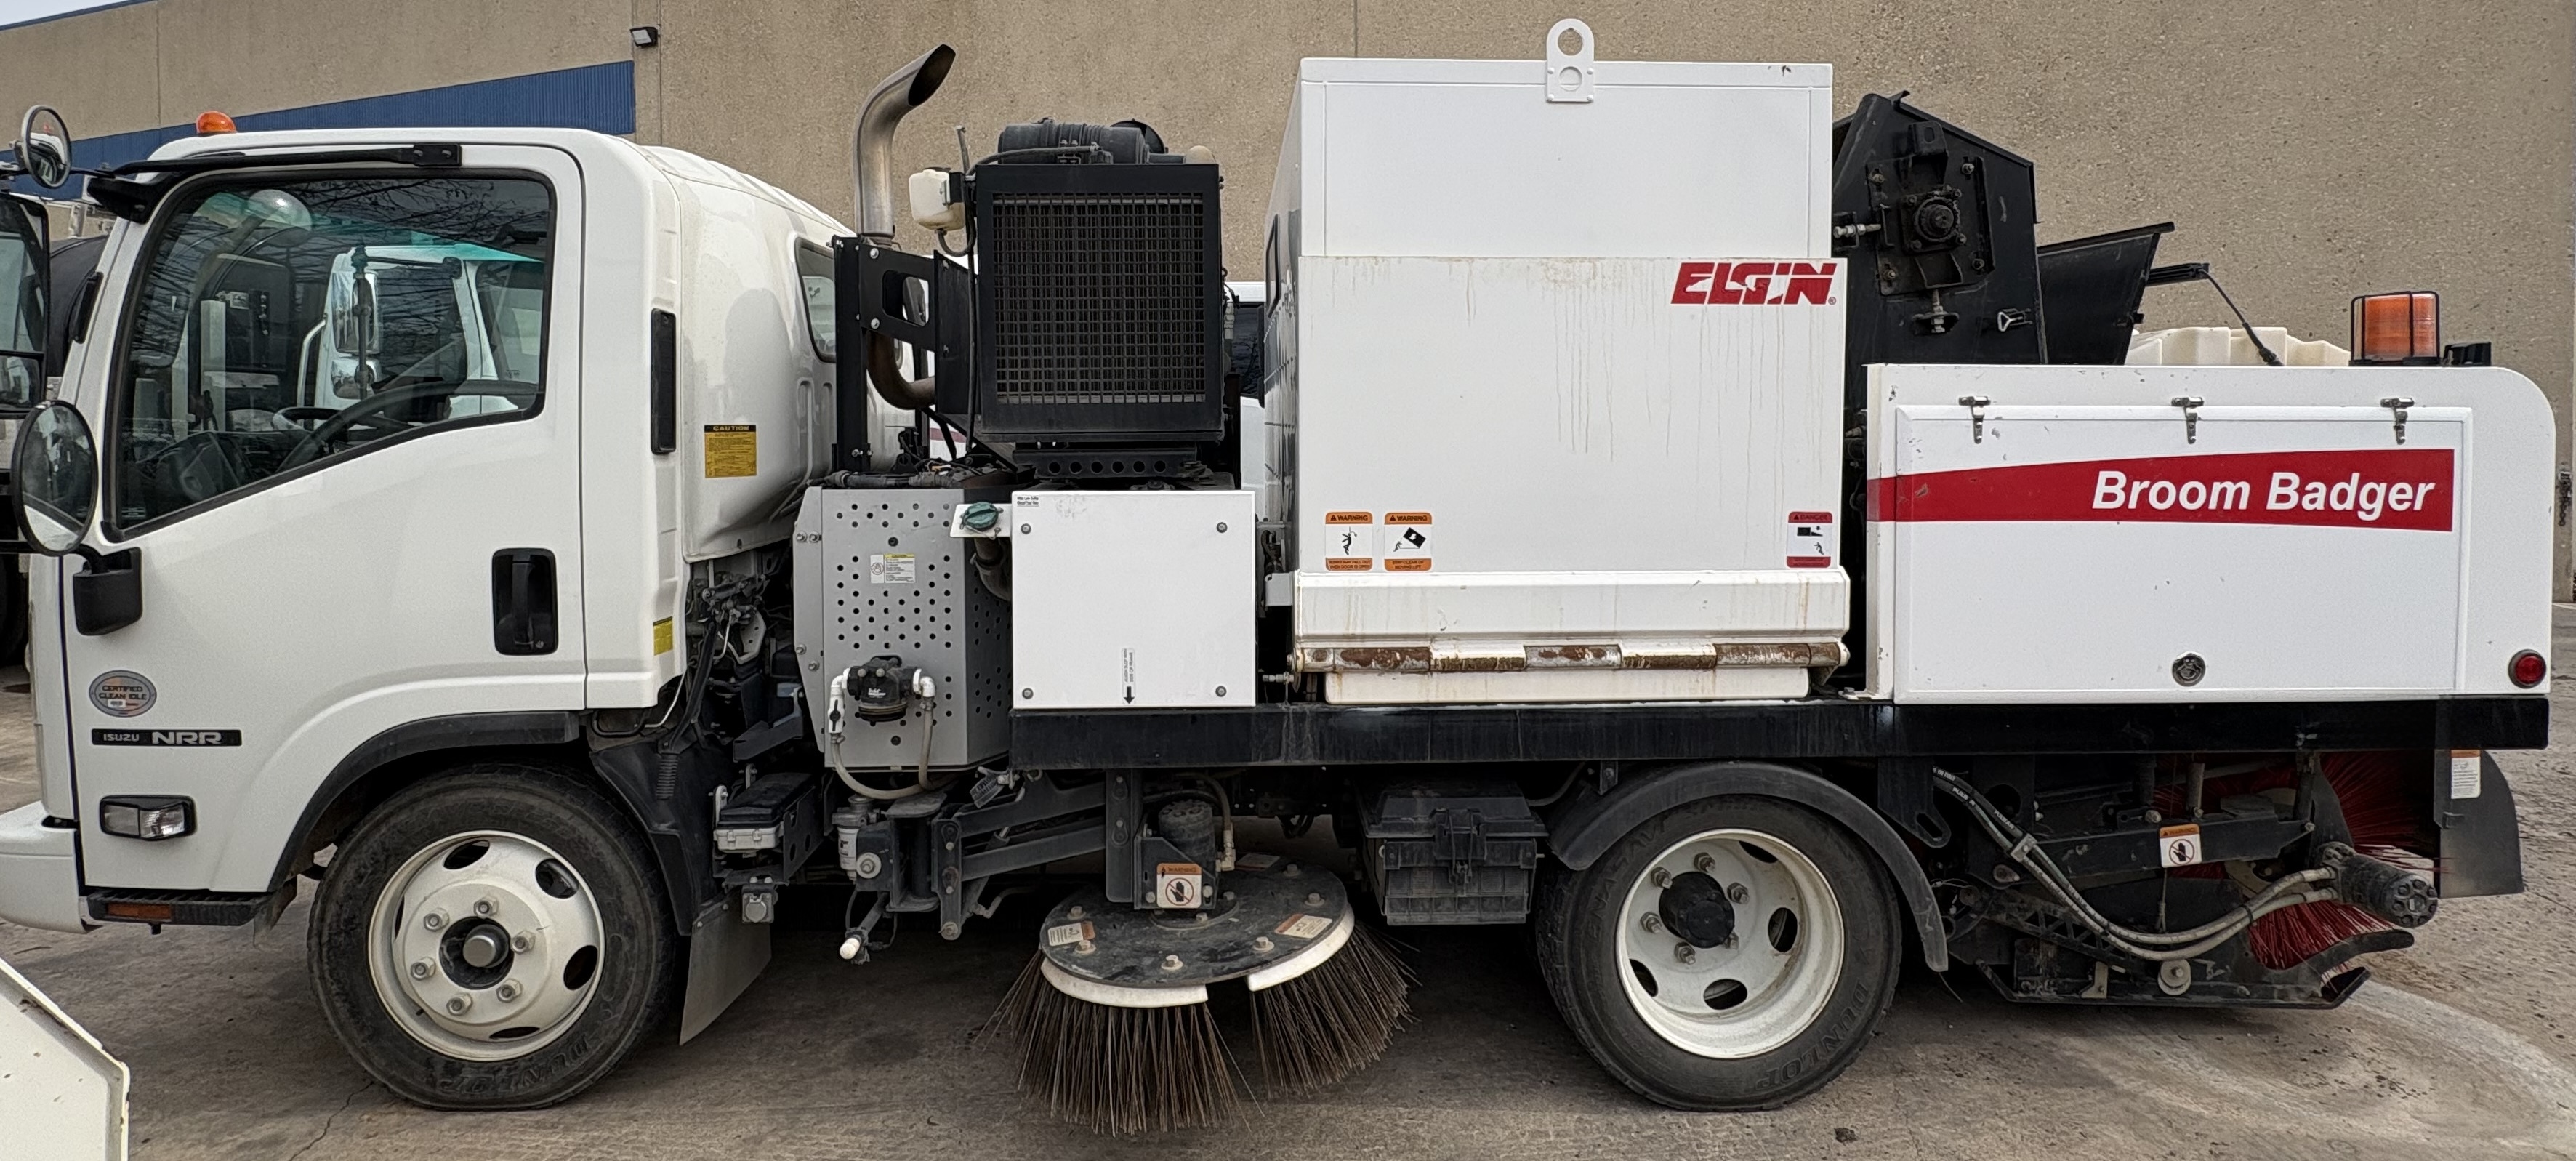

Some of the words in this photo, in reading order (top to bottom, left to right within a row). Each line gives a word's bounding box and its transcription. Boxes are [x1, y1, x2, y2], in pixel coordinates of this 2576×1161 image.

[1670, 262, 1838, 305] ELGIN
[2091, 470, 2251, 510] Broom
[2266, 471, 2436, 522] Badger
[103, 733, 140, 742] ISUZU
[151, 731, 222, 744] NRR
[1755, 980, 1869, 1091] DUNLOP
